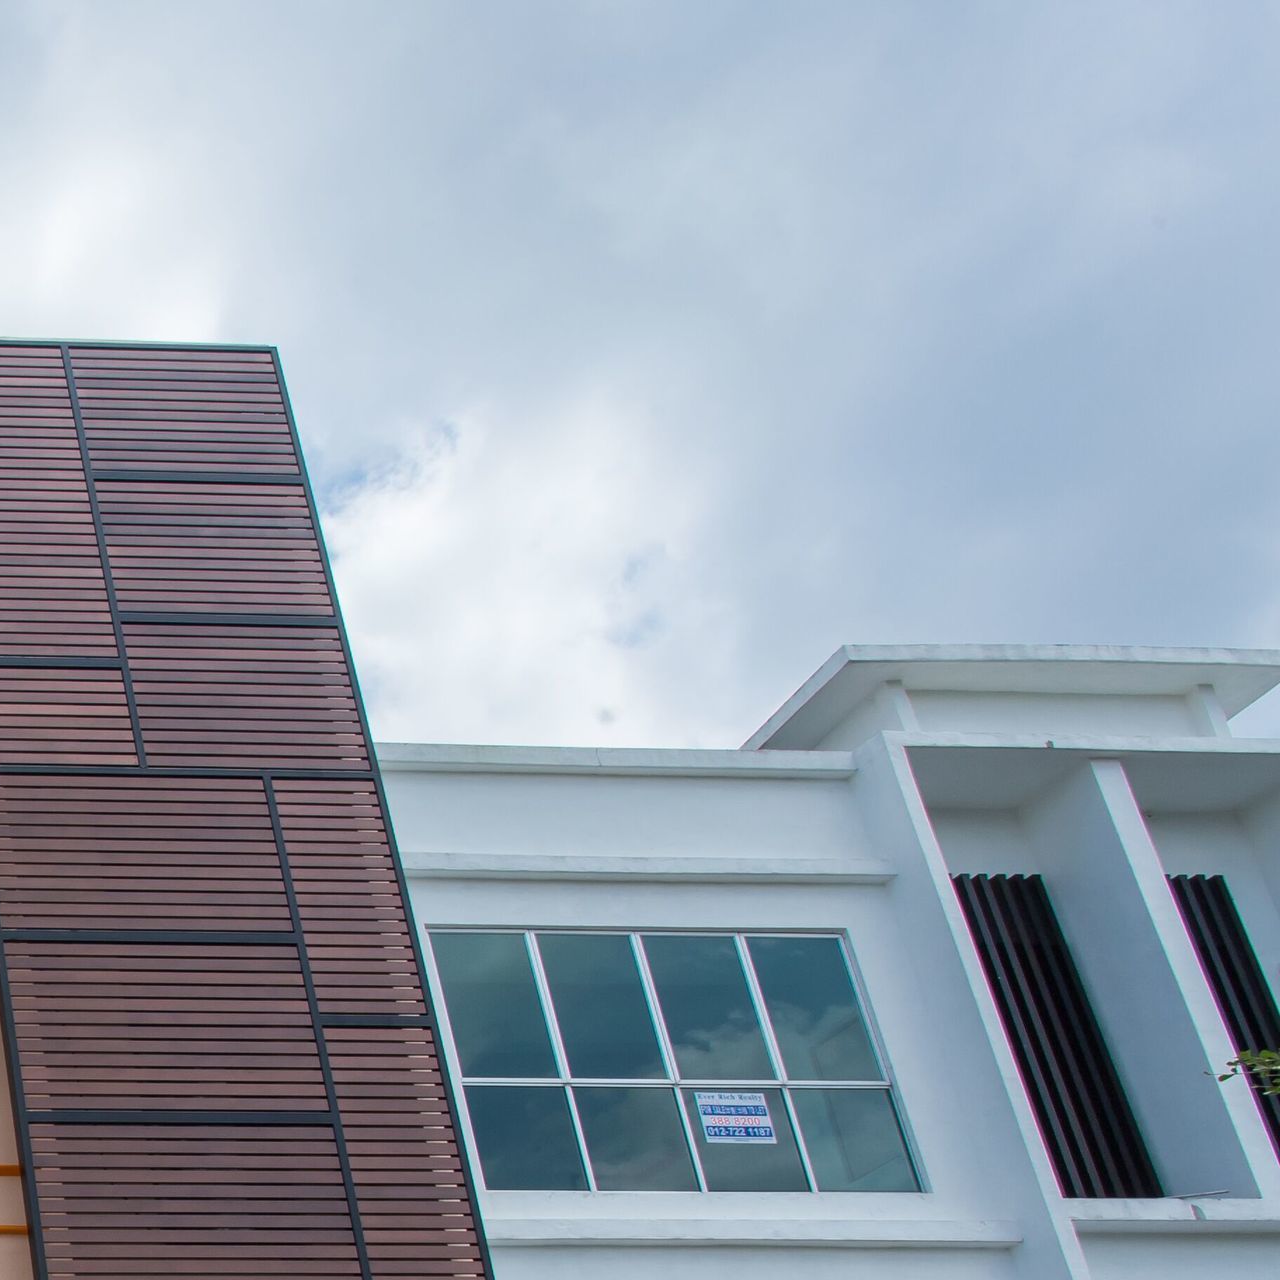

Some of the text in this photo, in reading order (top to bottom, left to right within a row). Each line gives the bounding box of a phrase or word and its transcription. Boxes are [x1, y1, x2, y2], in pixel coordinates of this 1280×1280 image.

[710, 1117, 761, 1126] 388 8200
[707, 1127, 772, 1137] 012-722 1187
